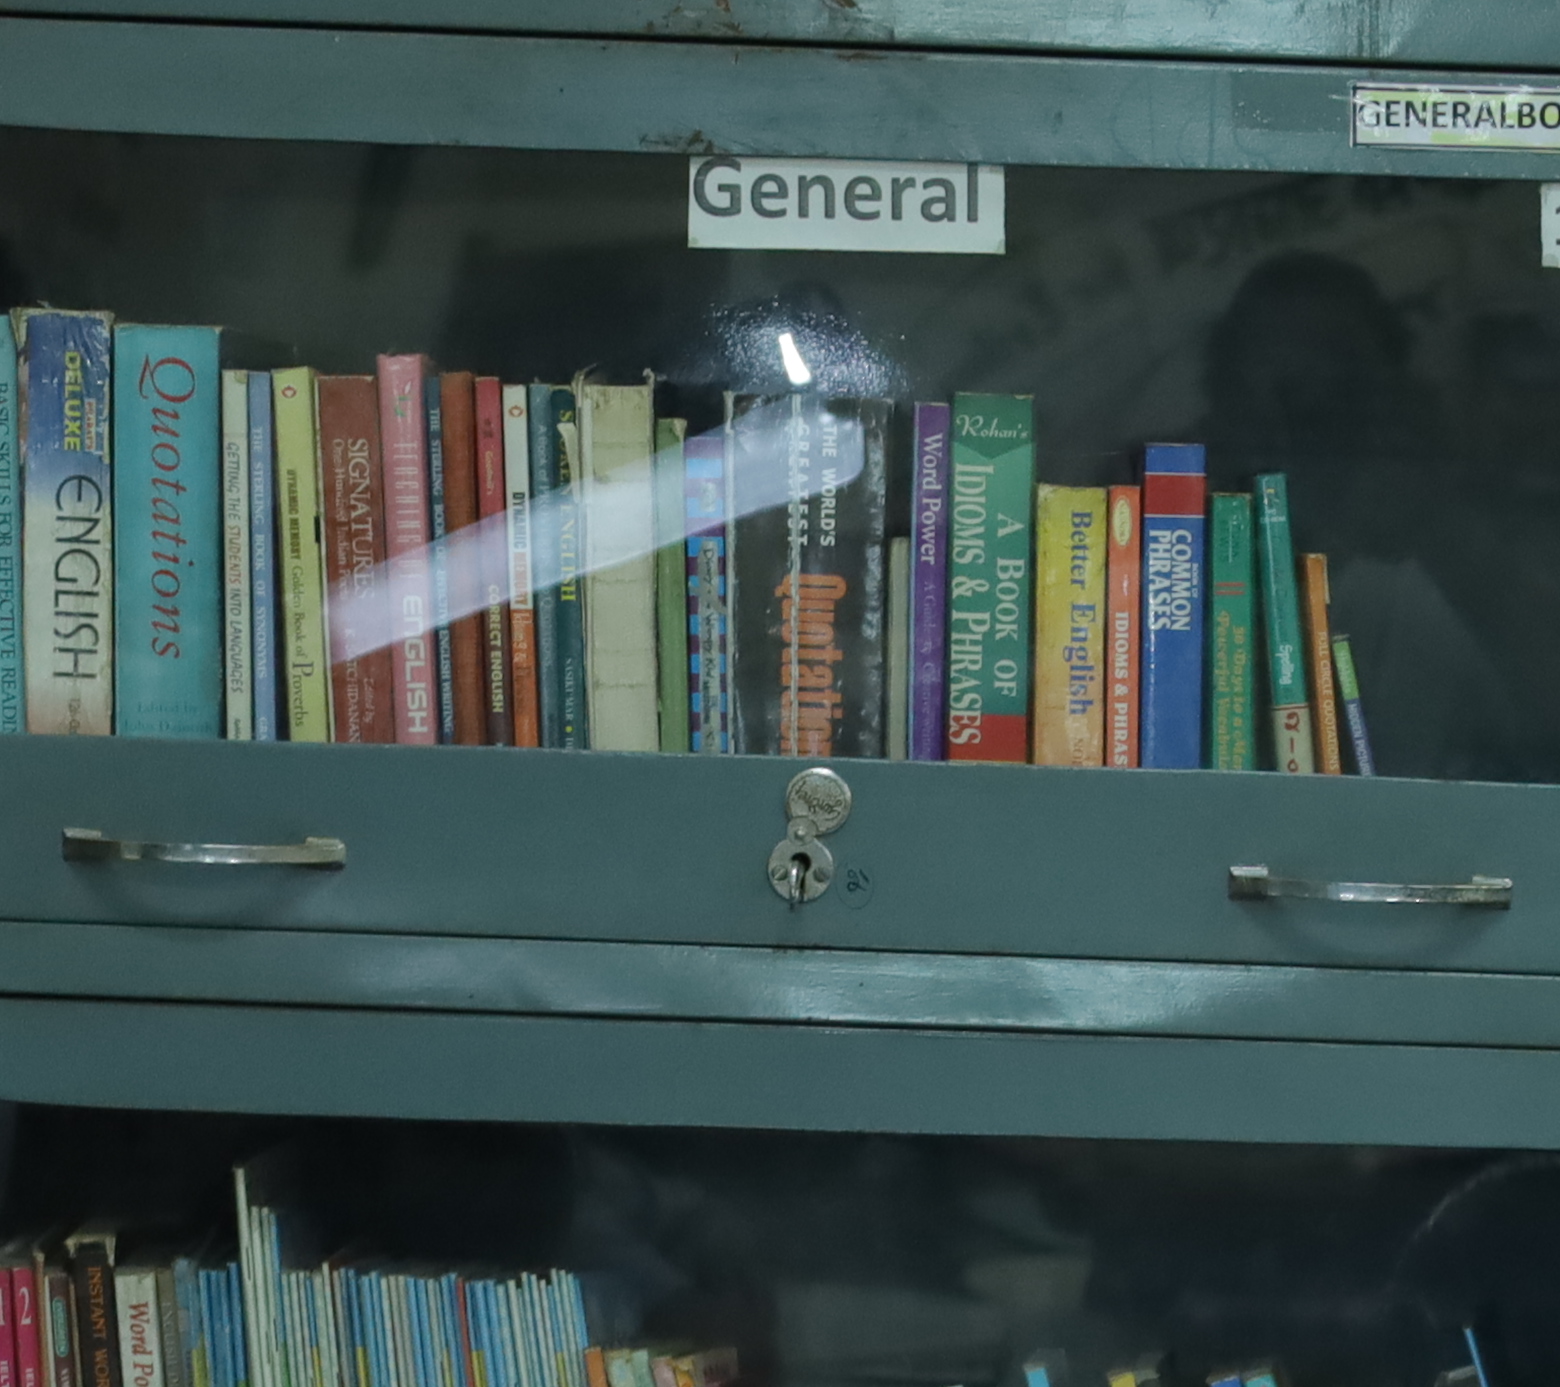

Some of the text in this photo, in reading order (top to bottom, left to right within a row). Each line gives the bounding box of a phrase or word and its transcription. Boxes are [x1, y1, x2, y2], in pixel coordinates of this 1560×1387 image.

[692, 157, 980, 224] General
[63, 352, 81, 451] DELUXE
[139, 354, 196, 660] Quotations
[347, 439, 374, 598] SIGNATURES
[560, 504, 576, 600] ENGLISH
[920, 433, 942, 564] Word Power
[53, 474, 102, 679] ENGLISH
[227, 442, 244, 693] GETTING THE STUDENTS INTO LANGUAGES
[950, 464, 994, 744] IDIOMS & PHRASES
[994, 513, 1025, 697] A BOOK OF
[1063, 511, 1096, 715] Better English
[1149, 530, 1171, 630] PHRASES
[1171, 530, 1191, 630] COMMON
[403, 595, 428, 732] ENGLISH
[487, 585, 504, 712] CORRECT ENGLISH
[88, 1266, 107, 1339] INSTANT
[129, 1302, 151, 1356] Word
